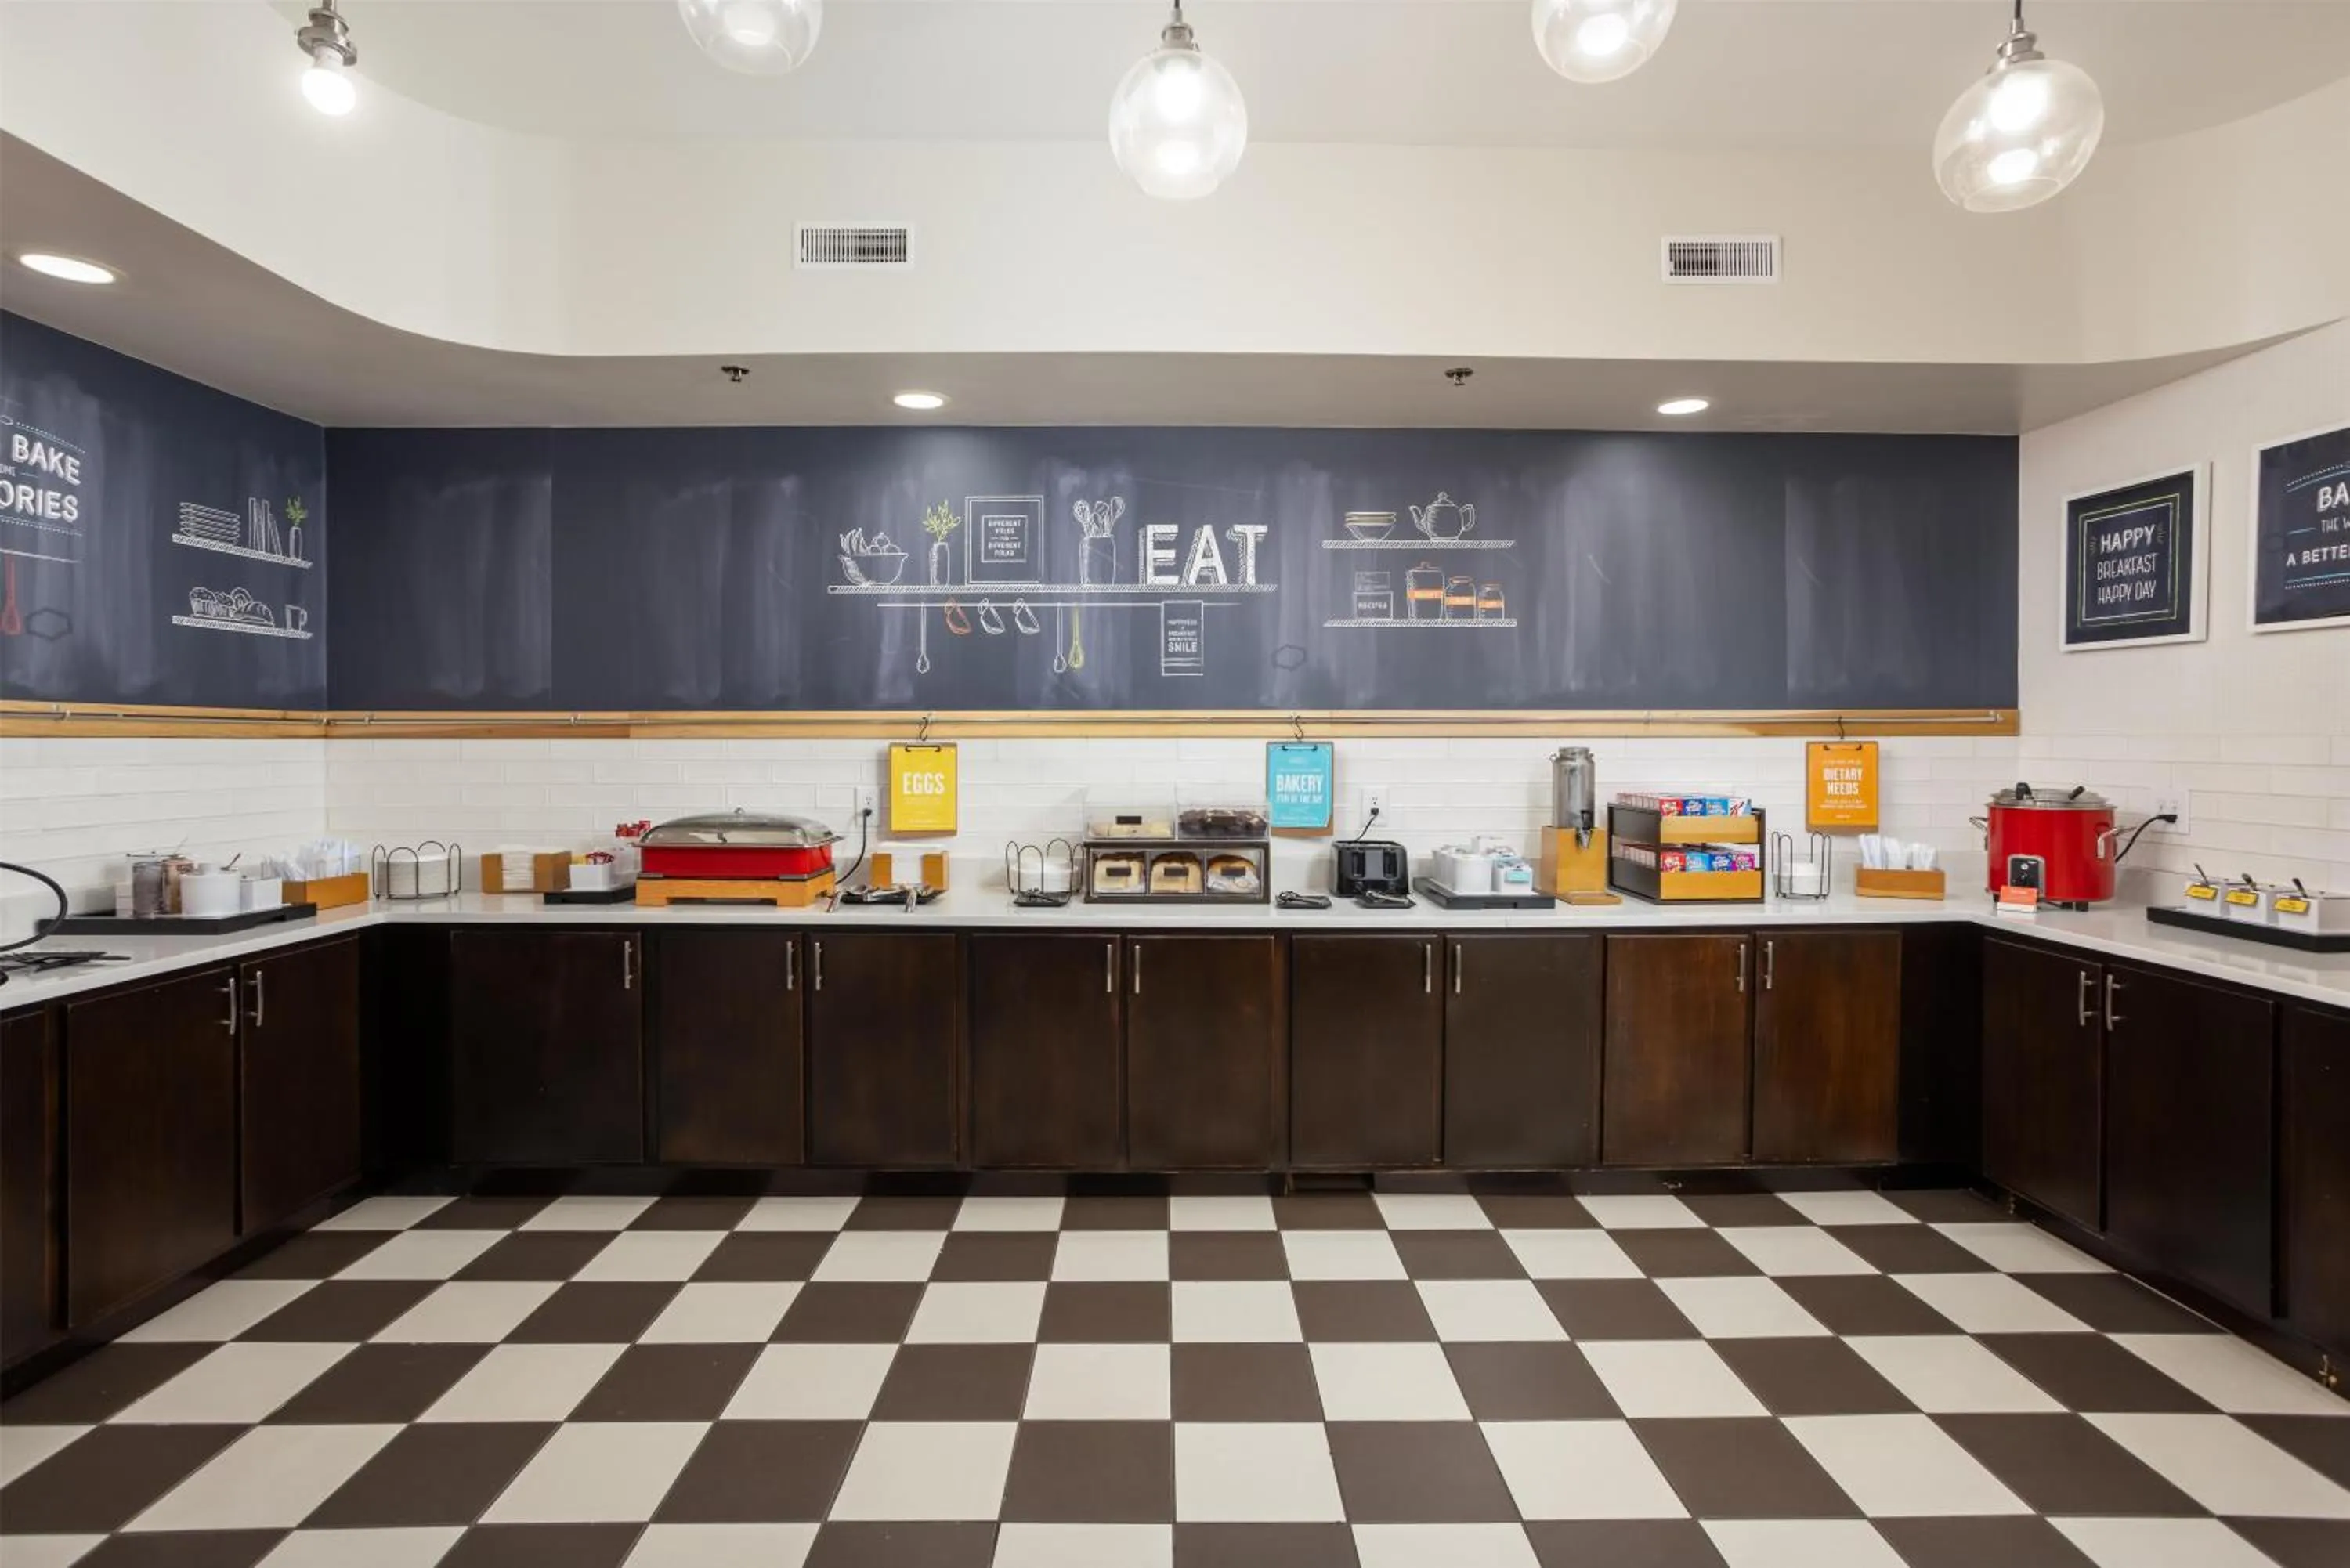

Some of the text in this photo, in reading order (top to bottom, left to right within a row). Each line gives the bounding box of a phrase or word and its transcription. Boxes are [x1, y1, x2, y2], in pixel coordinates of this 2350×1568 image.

[12, 433, 81, 486] BAKE
[2321, 518, 2339, 533] THE
[2101, 524, 2156, 554] HAPPY
[1138, 524, 1268, 586] EAT
[2097, 552, 2160, 580] BREAKFAST
[2286, 544, 2350, 567] A BETTE
[2097, 580, 2157, 605] HAPPY DAY
[1168, 642, 1197, 652] SMILE
[902, 771, 945, 795] EGGS
[1276, 775, 1324, 793] BAKERY
[1827, 782, 1859, 795] NEEDS
